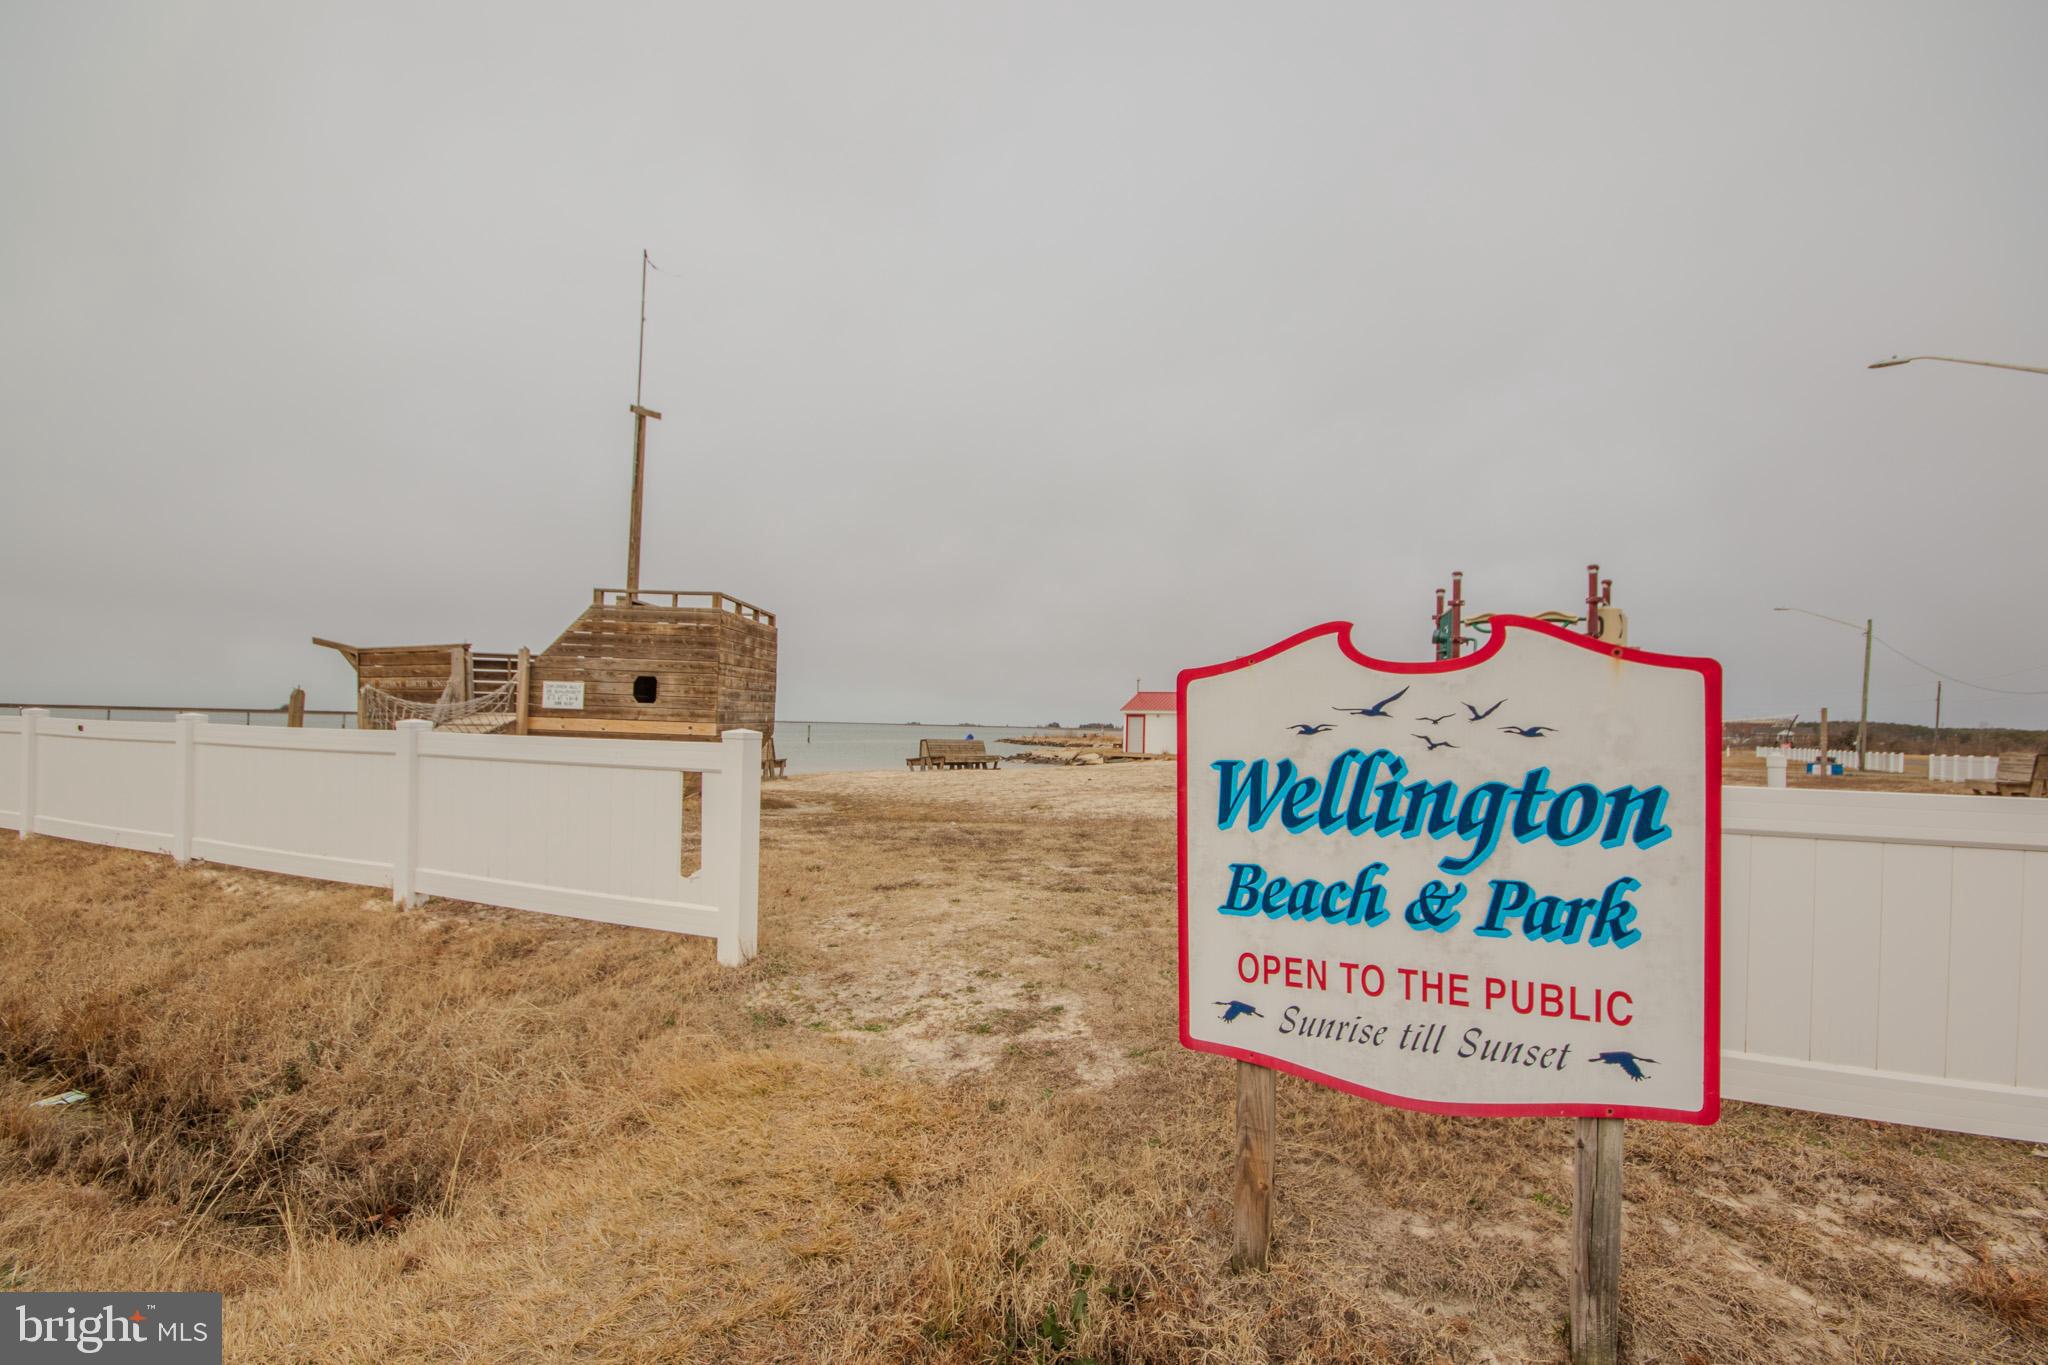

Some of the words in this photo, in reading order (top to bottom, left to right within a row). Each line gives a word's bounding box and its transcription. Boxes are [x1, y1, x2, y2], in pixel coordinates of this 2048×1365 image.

[1211, 747, 1672, 876] Wellington
[1218, 861, 1390, 928] Beach
[1404, 877, 1467, 933] &
[1474, 875, 1642, 949] Park
[1237, 952, 1327, 991] OPEN
[1339, 962, 1385, 997] TO
[1397, 968, 1471, 1007] THE
[1485, 978, 1634, 1027] PUBLIC
[1278, 1006, 1388, 1048] Sunrise
[1400, 1024, 1447, 1055] till
[1457, 1028, 1573, 1072] Sunset
